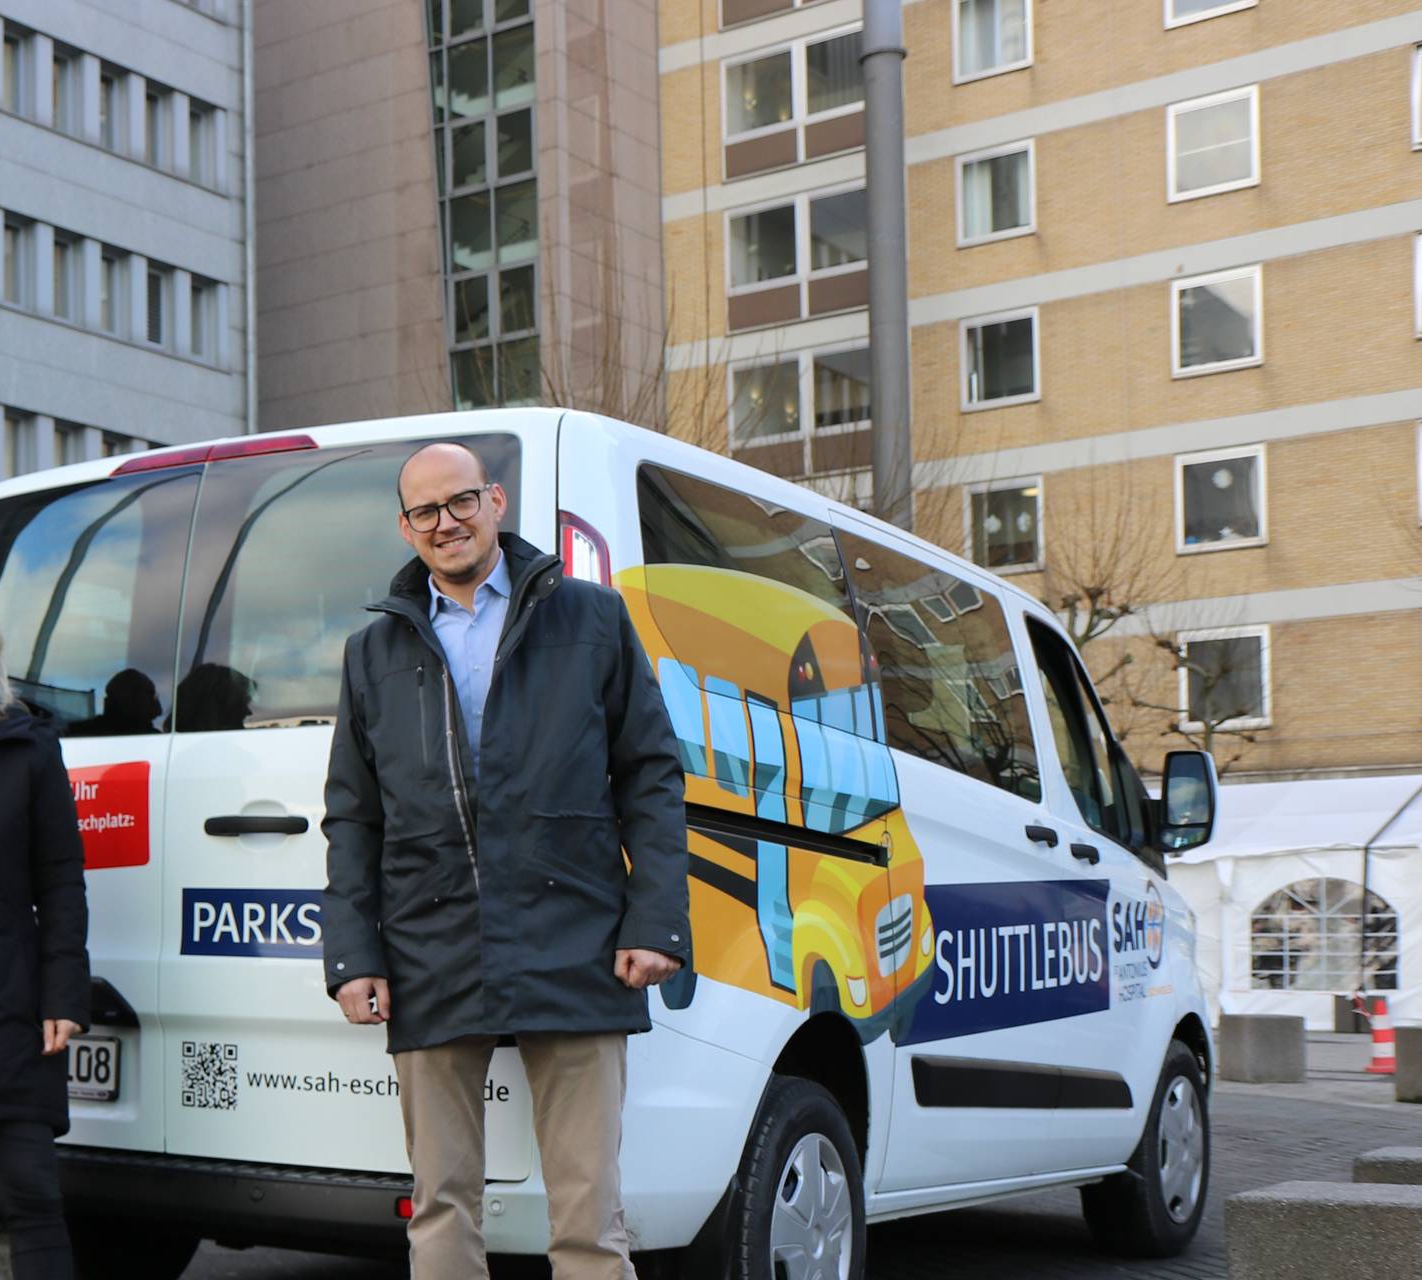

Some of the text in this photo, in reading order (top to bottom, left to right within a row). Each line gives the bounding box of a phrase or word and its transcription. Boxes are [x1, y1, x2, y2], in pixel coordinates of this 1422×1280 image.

[193, 902, 322, 946] PARKS
[1112, 901, 1147, 953] SAH
[934, 918, 1103, 1004] SHUTTLEBUS
